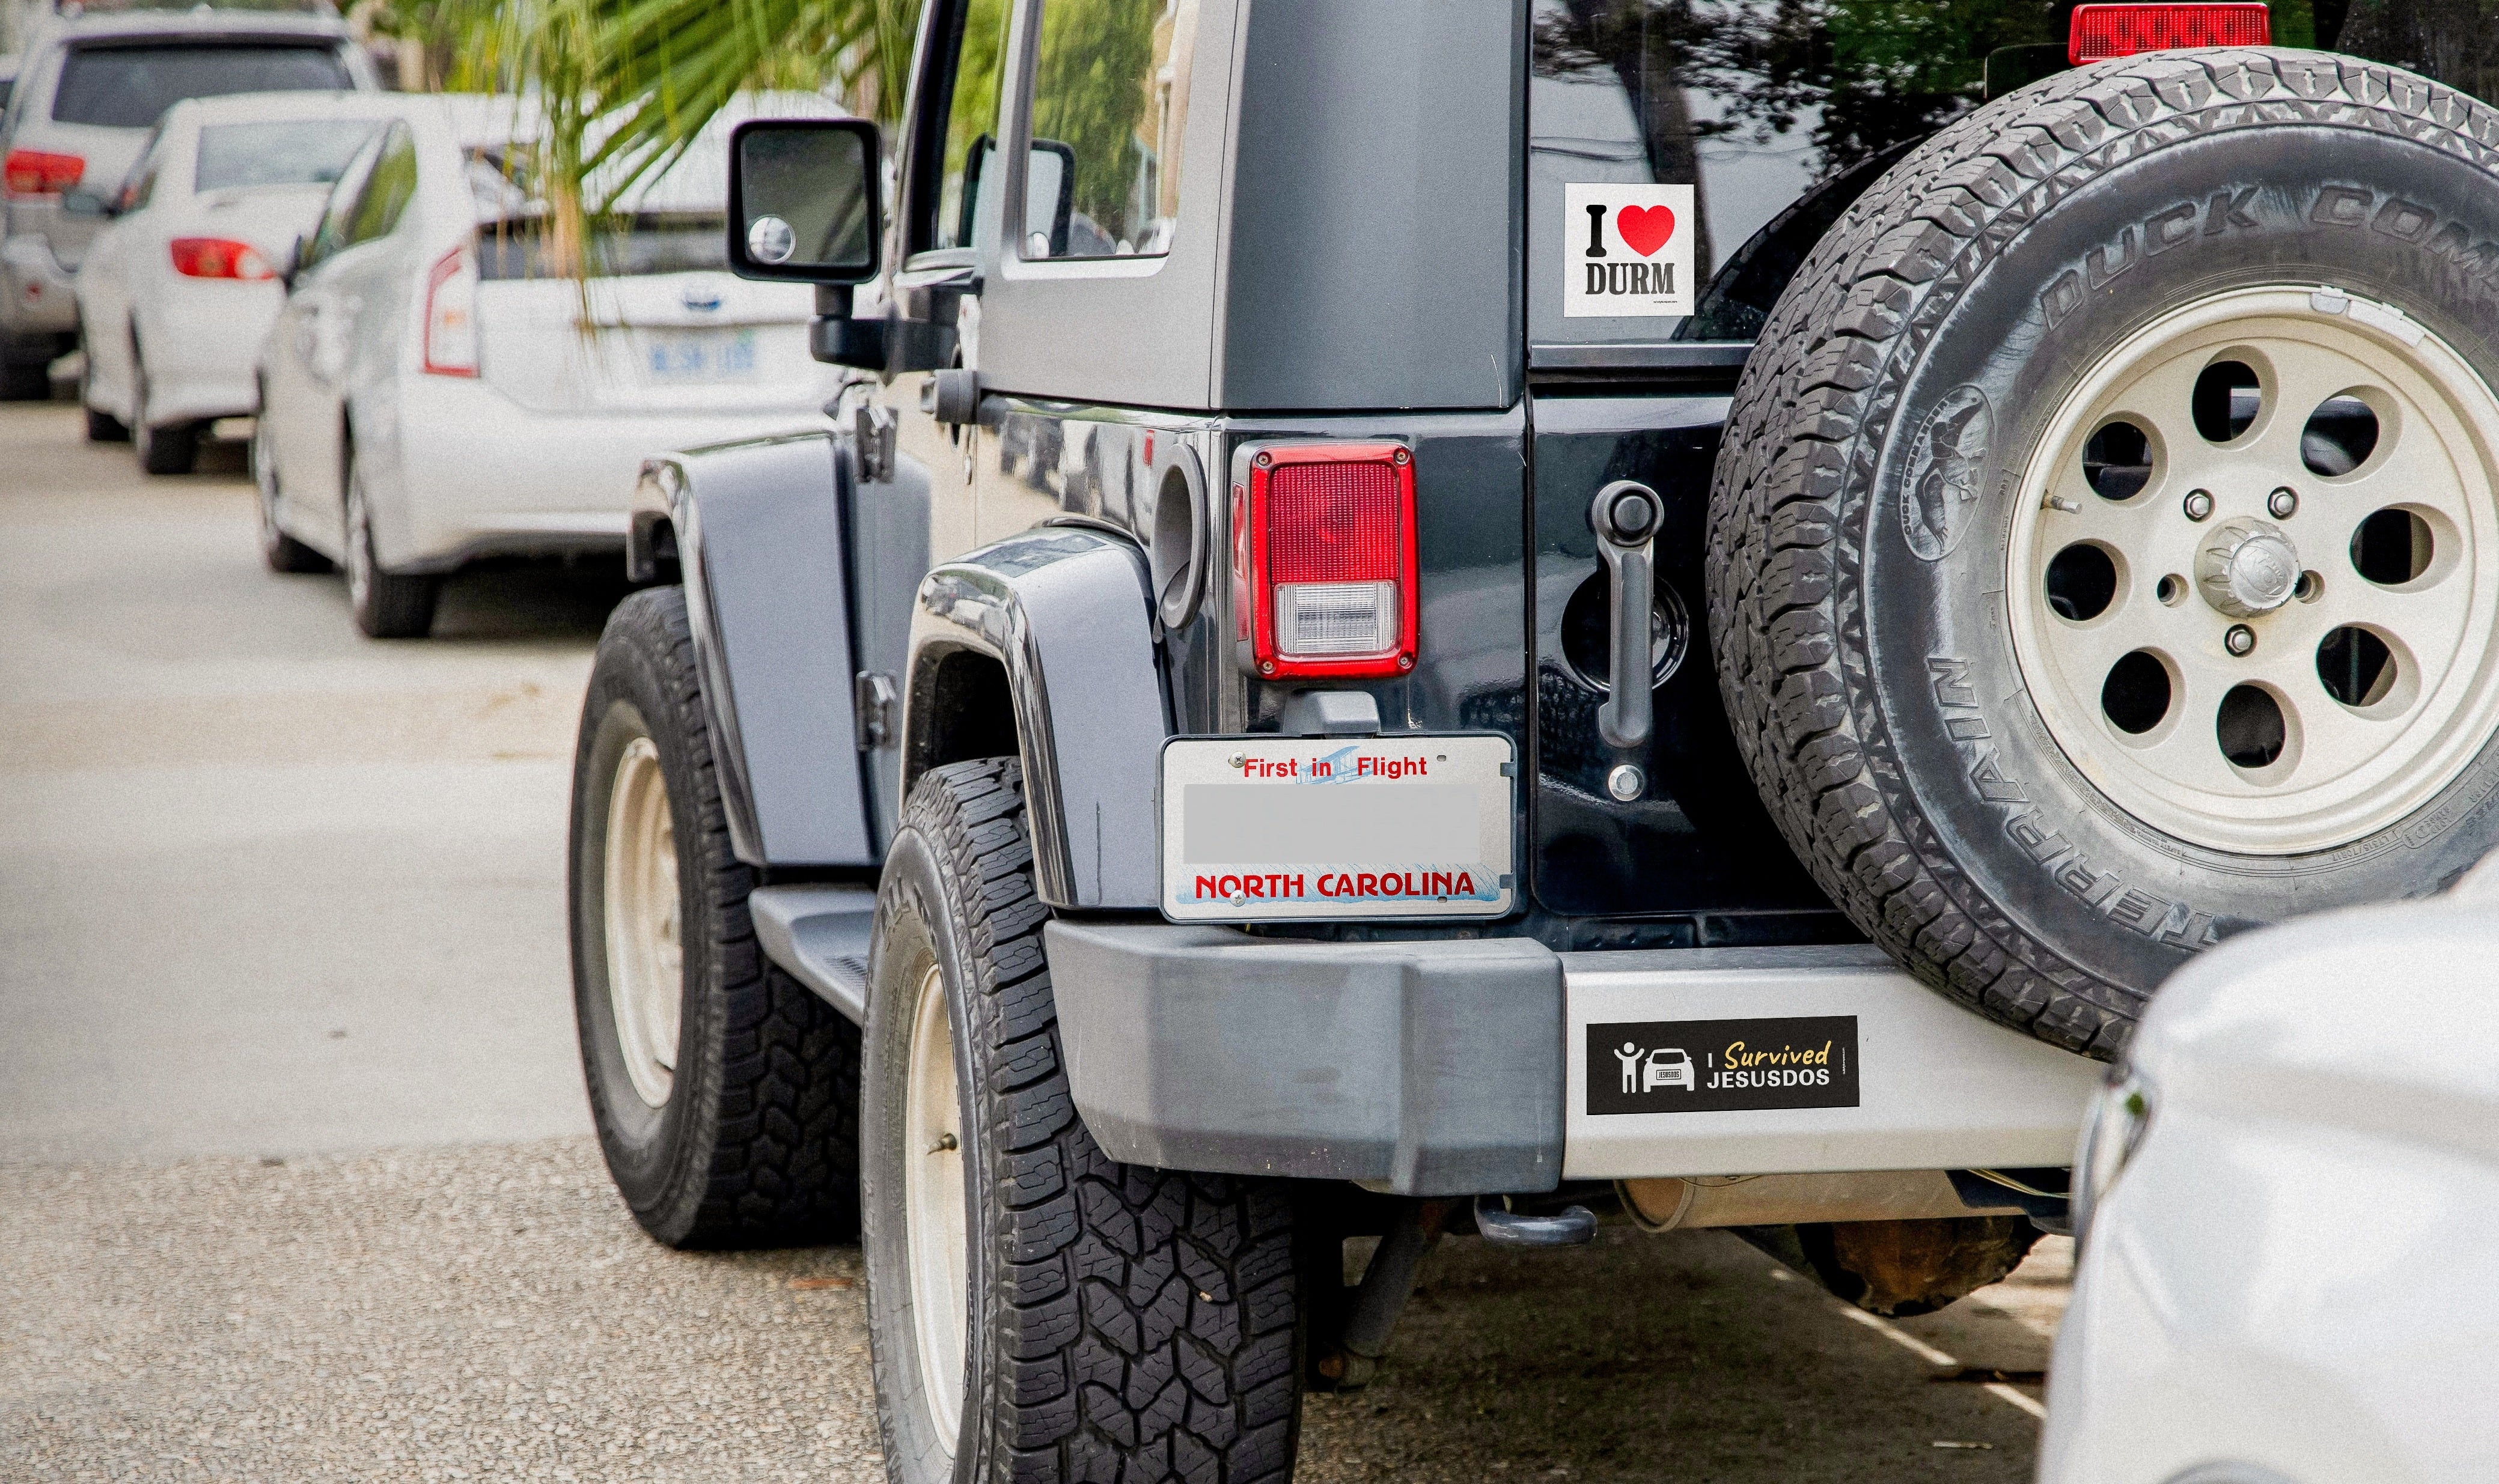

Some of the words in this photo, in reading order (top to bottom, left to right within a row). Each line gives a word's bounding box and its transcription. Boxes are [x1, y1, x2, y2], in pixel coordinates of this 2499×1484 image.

[1586, 204, 1607, 257] I
[2041, 186, 2261, 331] DUCK
[1585, 263, 1676, 295] DURM
[1243, 758, 1297, 777] First
[1311, 758, 1331, 777] in
[1357, 756, 1428, 779] Flight
[1927, 657, 2218, 952] TERRAIN
[1195, 874, 1304, 899] NORTH
[1316, 872, 1475, 898] CAROLINA
[1707, 1052, 1713, 1068] I
[1724, 1040, 1832, 1069] Survived
[1706, 1068, 1830, 1089] JESUSDOS
